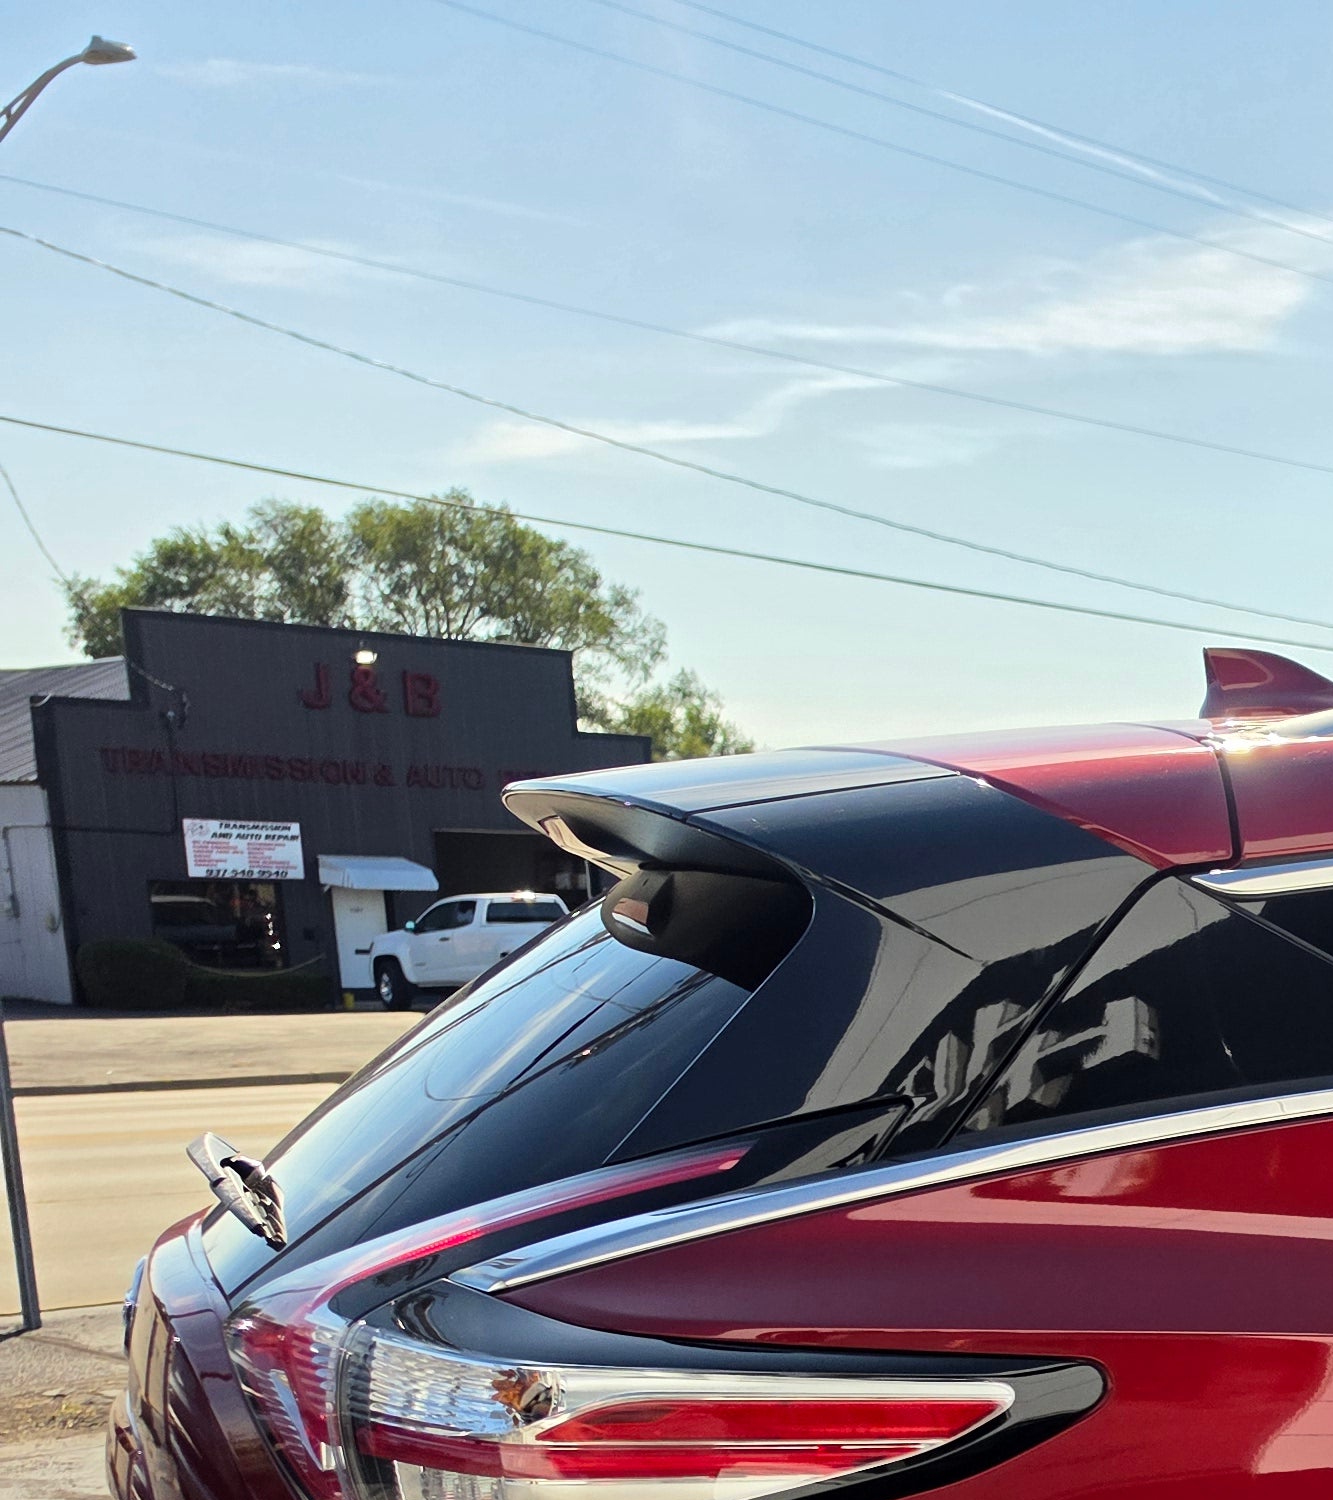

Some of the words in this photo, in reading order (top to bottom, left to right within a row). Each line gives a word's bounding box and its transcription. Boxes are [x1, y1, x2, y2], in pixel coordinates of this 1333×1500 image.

[296, 662, 332, 710] J
[348, 663, 391, 713] &
[402, 668, 442, 718] B
[99, 747, 366, 786] TRANSMISSION
[373, 761, 399, 787] &
[405, 763, 484, 790] AUTO
